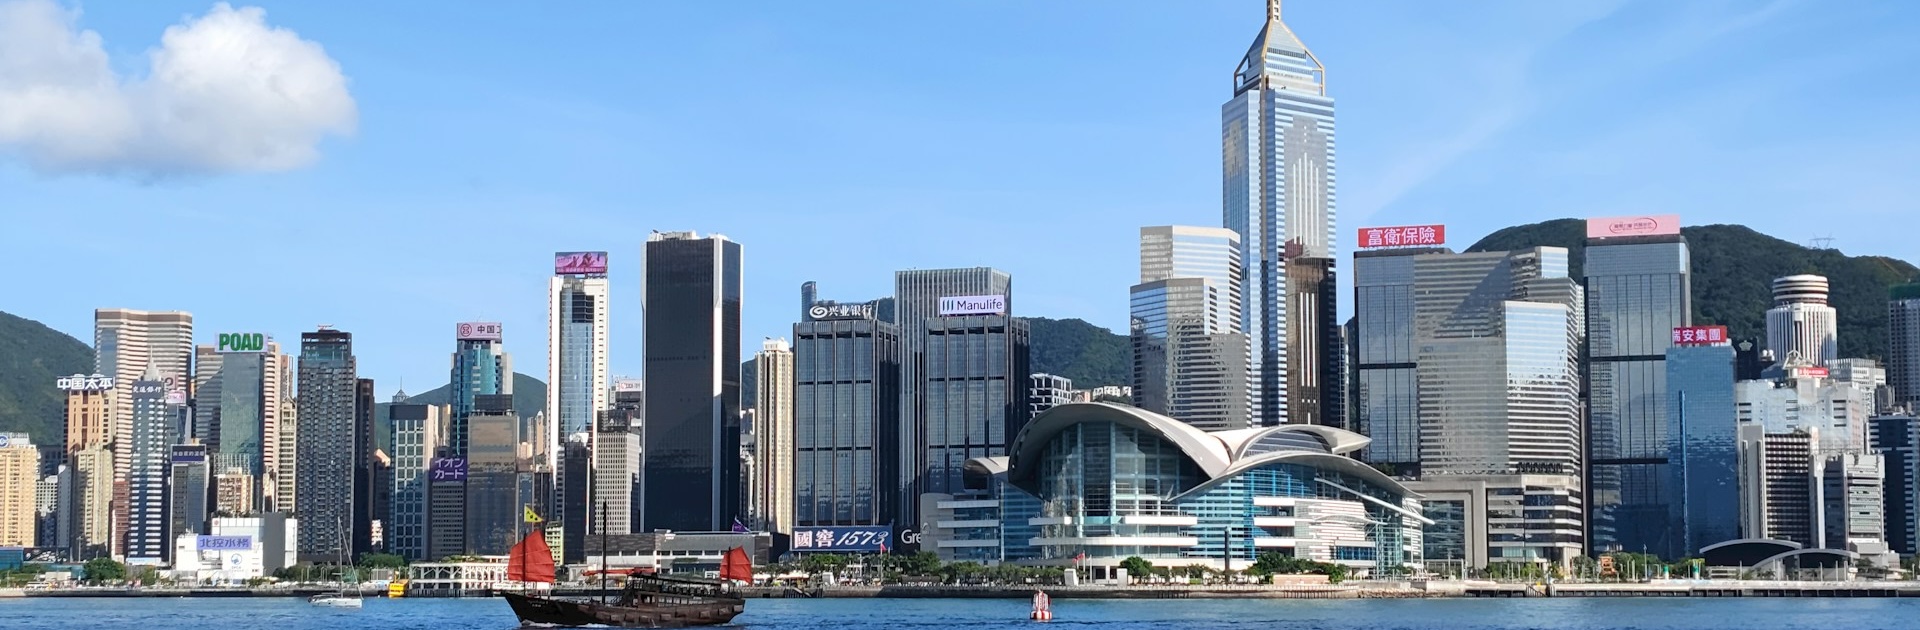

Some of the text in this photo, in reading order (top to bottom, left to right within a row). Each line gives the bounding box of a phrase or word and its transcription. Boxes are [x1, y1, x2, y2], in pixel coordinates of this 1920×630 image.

[1367, 226, 1436, 246] 富衛保險
[957, 299, 1002, 310] Manulife
[219, 332, 264, 351] POAD
[56, 377, 112, 390] 中国太平
[434, 457, 464, 468] イオン
[434, 469, 464, 479] カード
[199, 538, 249, 548] 北控水務
[794, 529, 889, 549] 國窖 1573
